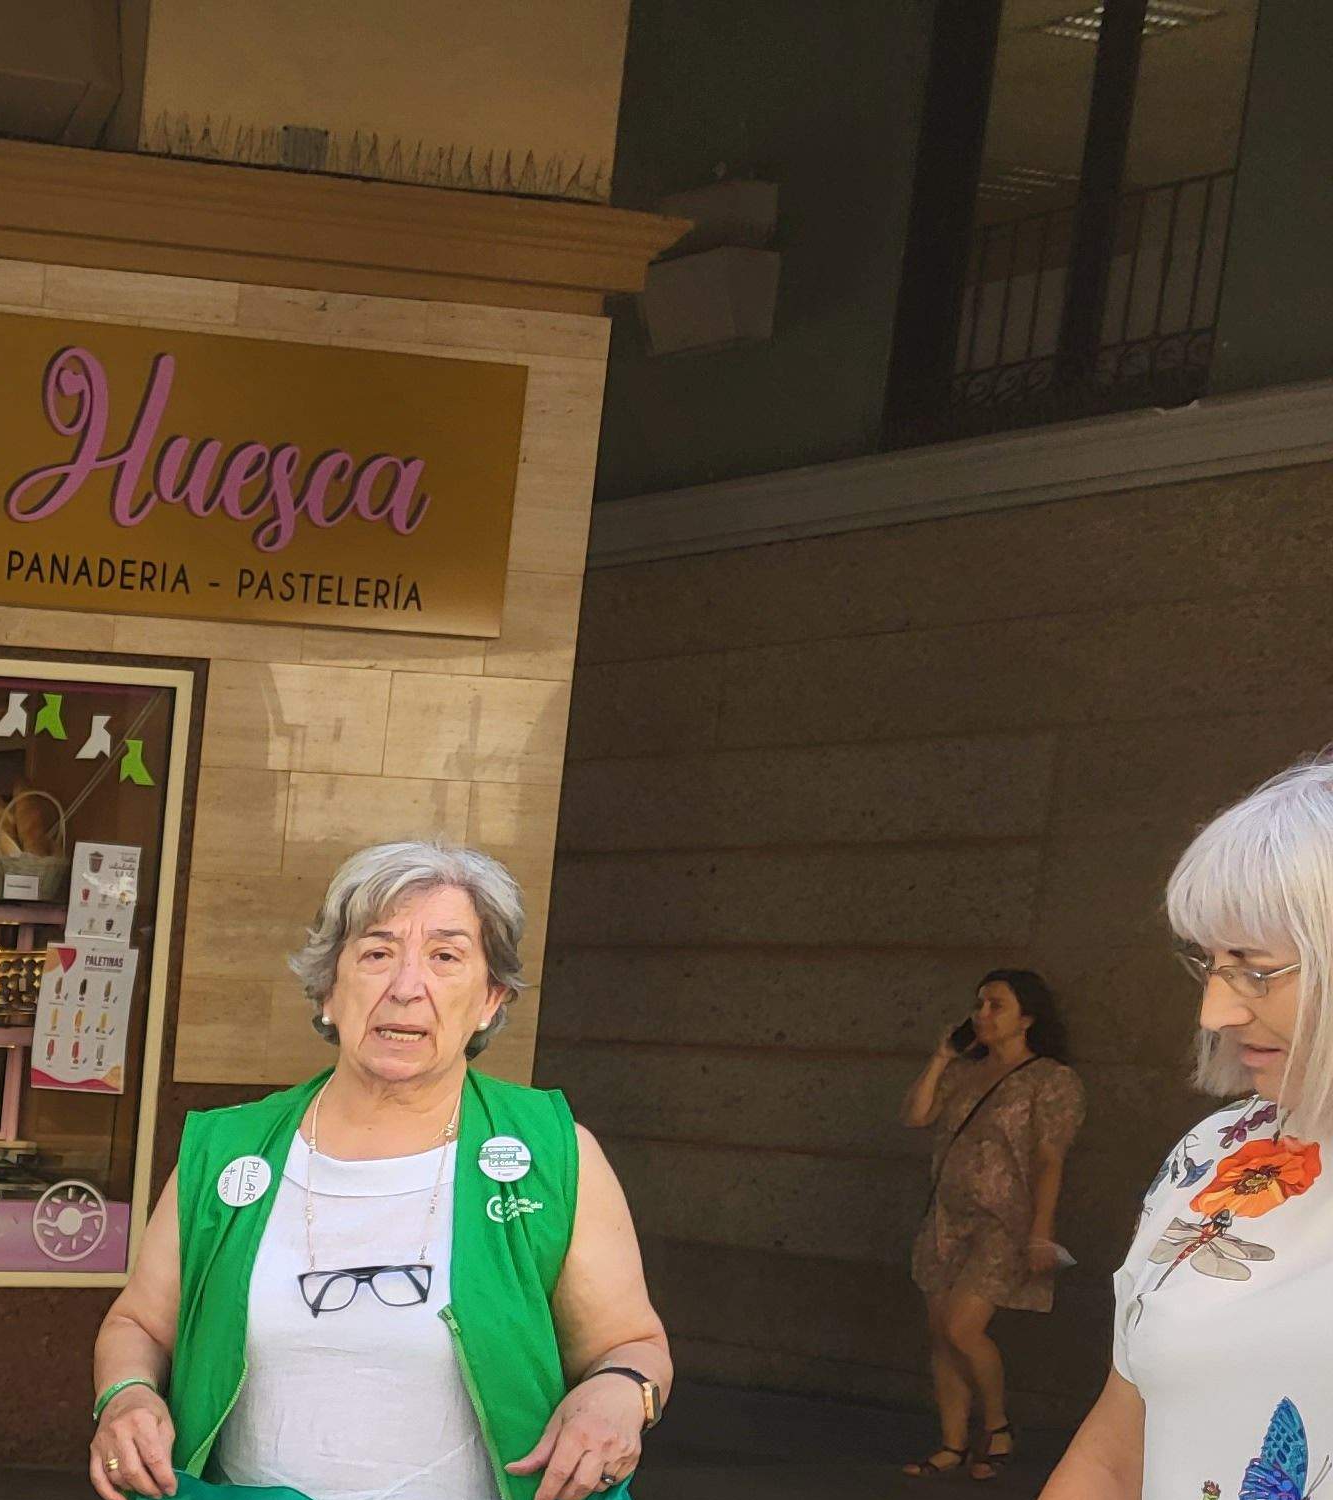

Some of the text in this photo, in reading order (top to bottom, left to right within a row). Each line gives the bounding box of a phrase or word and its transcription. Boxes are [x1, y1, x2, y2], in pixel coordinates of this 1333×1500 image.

[4, 345, 431, 553] Huesca
[7, 550, 190, 594] PANADERIA
[238, 569, 423, 612] PASTELERÍA
[85, 955, 124, 968] PALETINAS
[243, 1160, 262, 1202] PILAR
